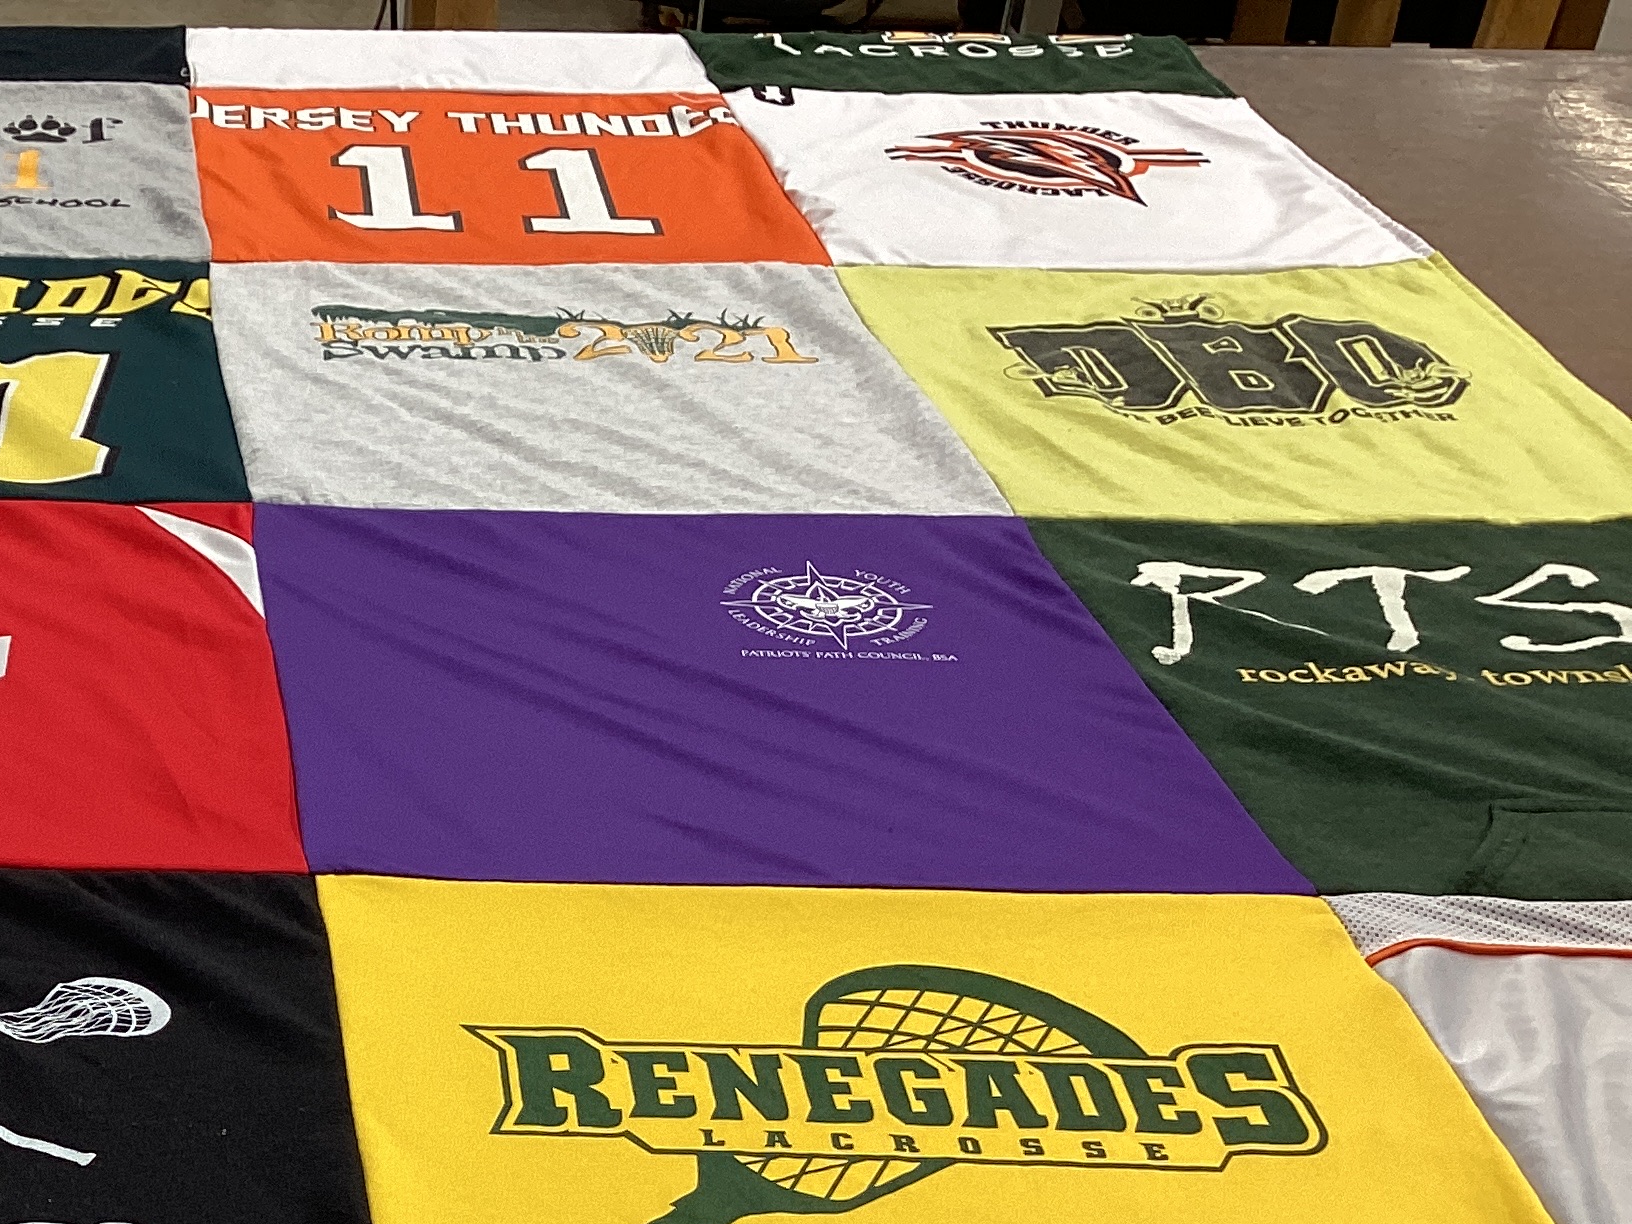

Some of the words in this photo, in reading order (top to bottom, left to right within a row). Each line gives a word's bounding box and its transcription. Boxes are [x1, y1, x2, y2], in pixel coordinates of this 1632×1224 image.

[754, 32, 1135, 58] LACROSSE
[979, 120, 1141, 147] THUNDER
[940, 165, 1110, 199] LACROSSE
[314, 322, 492, 346] Romp
[320, 340, 568, 361] Swamp
[722, 565, 783, 596] NATIONAL
[854, 569, 911, 595] YOUTH
[728, 608, 817, 647] LEADERSHIP
[869, 616, 928, 647] TRAINING
[816, 650, 853, 659] PATH
[932, 653, 959, 661] BSA
[511, 1034, 1309, 1147] RENEGADES
[701, 1128, 1172, 1161] LACROSSE
